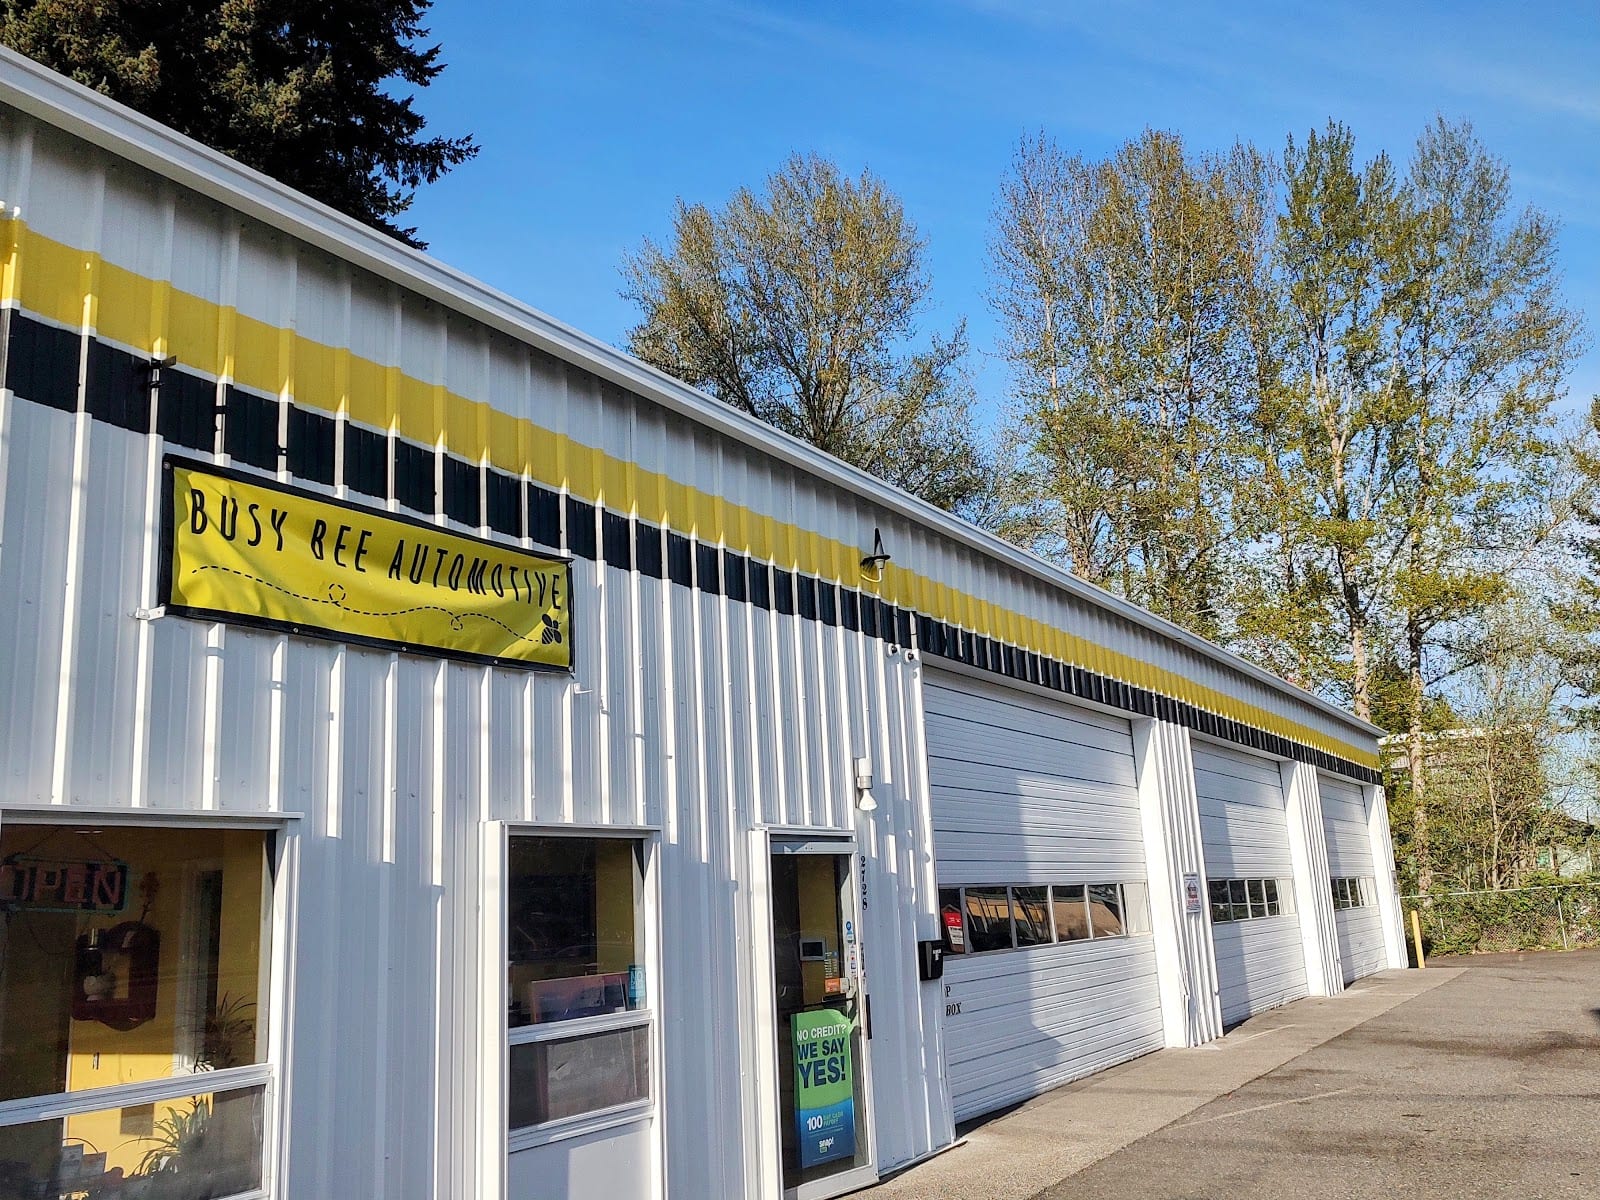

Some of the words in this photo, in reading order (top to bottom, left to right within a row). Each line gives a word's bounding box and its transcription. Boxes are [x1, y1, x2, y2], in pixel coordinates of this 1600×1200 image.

[191, 488, 289, 551] BUSY
[310, 518, 373, 574] BEE
[388, 539, 561, 610] AUTOMOTIVE
[945, 1002, 962, 1017] BOX
[796, 1029, 809, 1041] NO
[810, 1024, 847, 1039] CREDIT?
[797, 1041, 818, 1061] WE
[821, 1037, 845, 1056] SAY
[797, 1055, 846, 1089] YES!
[806, 1115, 823, 1131] 100
